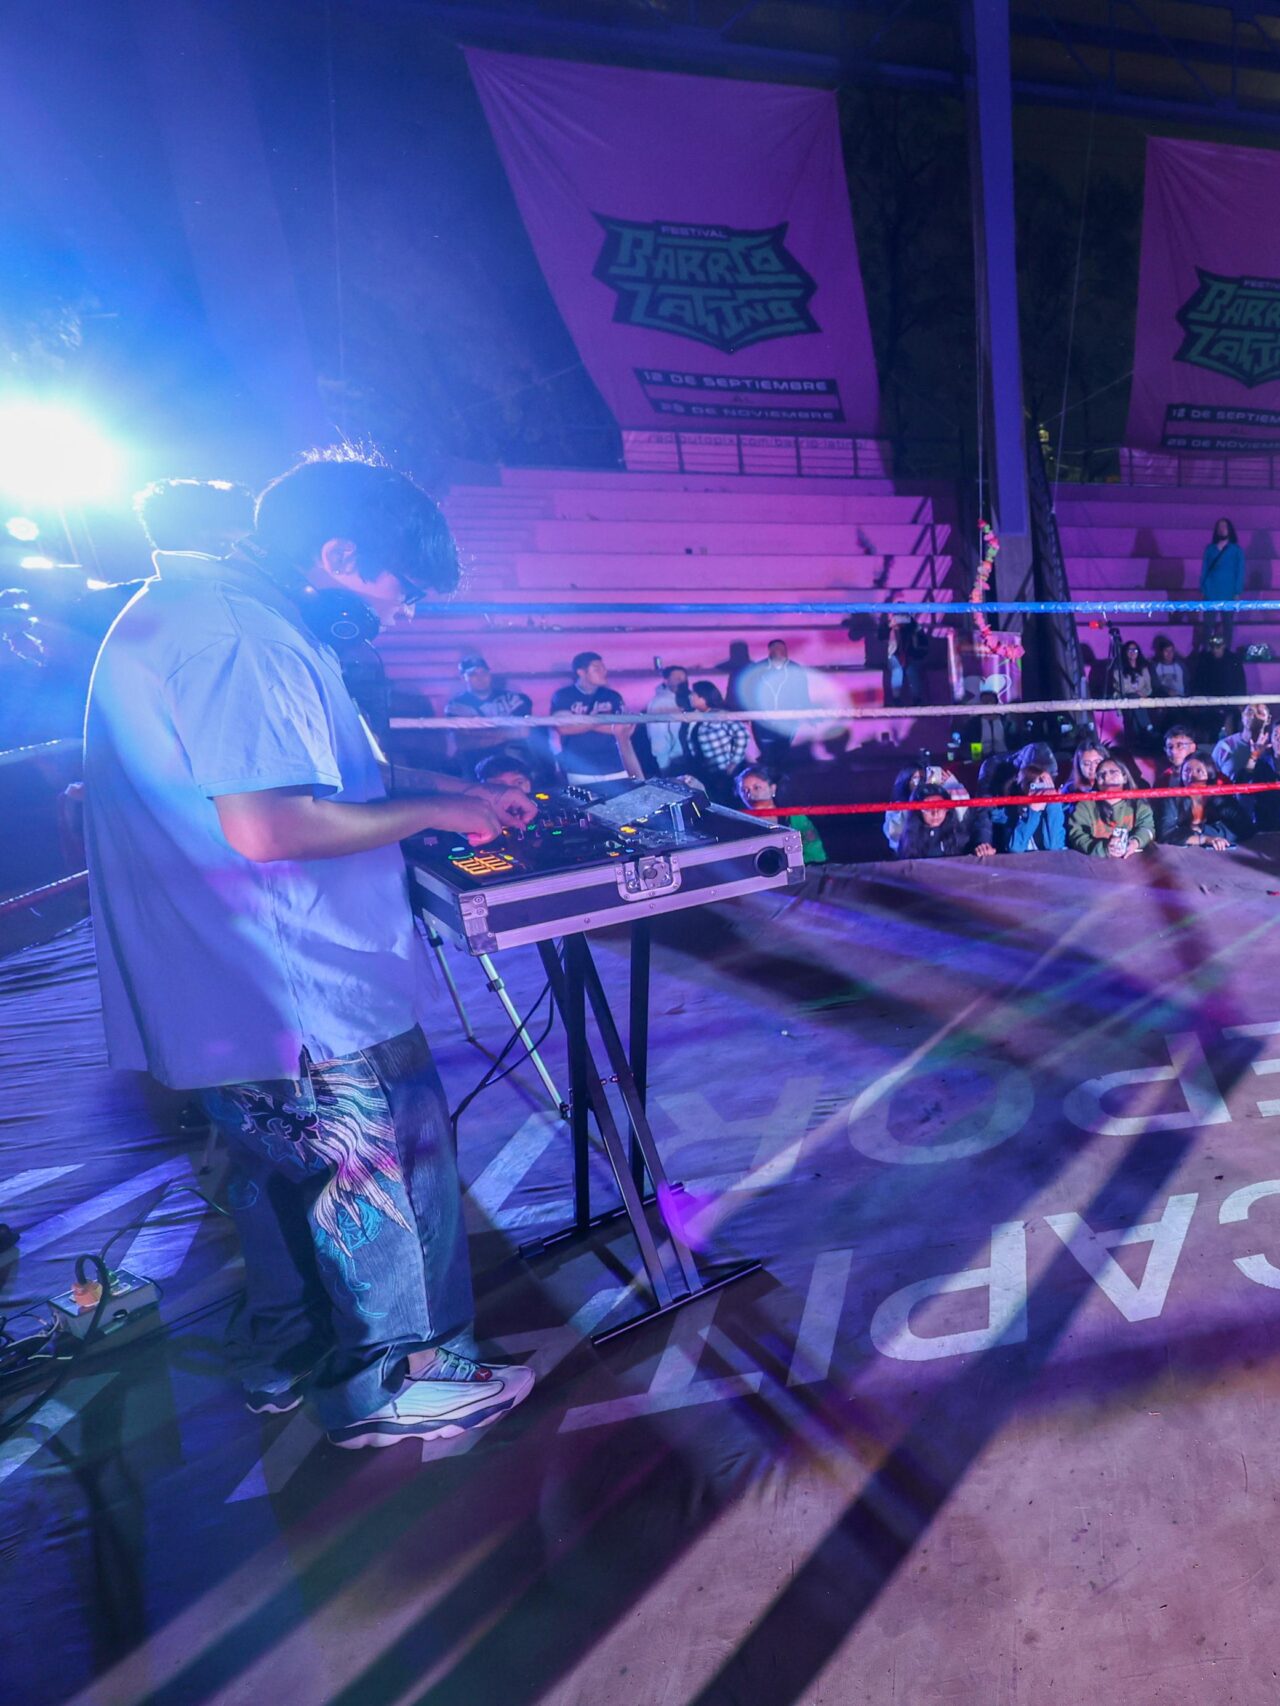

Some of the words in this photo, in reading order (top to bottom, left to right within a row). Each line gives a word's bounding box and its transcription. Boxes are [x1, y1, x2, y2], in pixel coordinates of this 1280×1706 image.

[660, 225, 729, 239] FESTIVAL
[607, 224, 804, 285] BARRIO
[612, 281, 808, 347] LATINO
[644, 370, 664, 383] 12
[670, 373, 697, 386] DE
[703, 376, 828, 392] SEPTIEMBRE
[692, 406, 717, 416] DE
[723, 408, 834, 421] NOVIEMBRE
[1191, 409, 1211, 419] DE
[1191, 438, 1211, 448] DE
